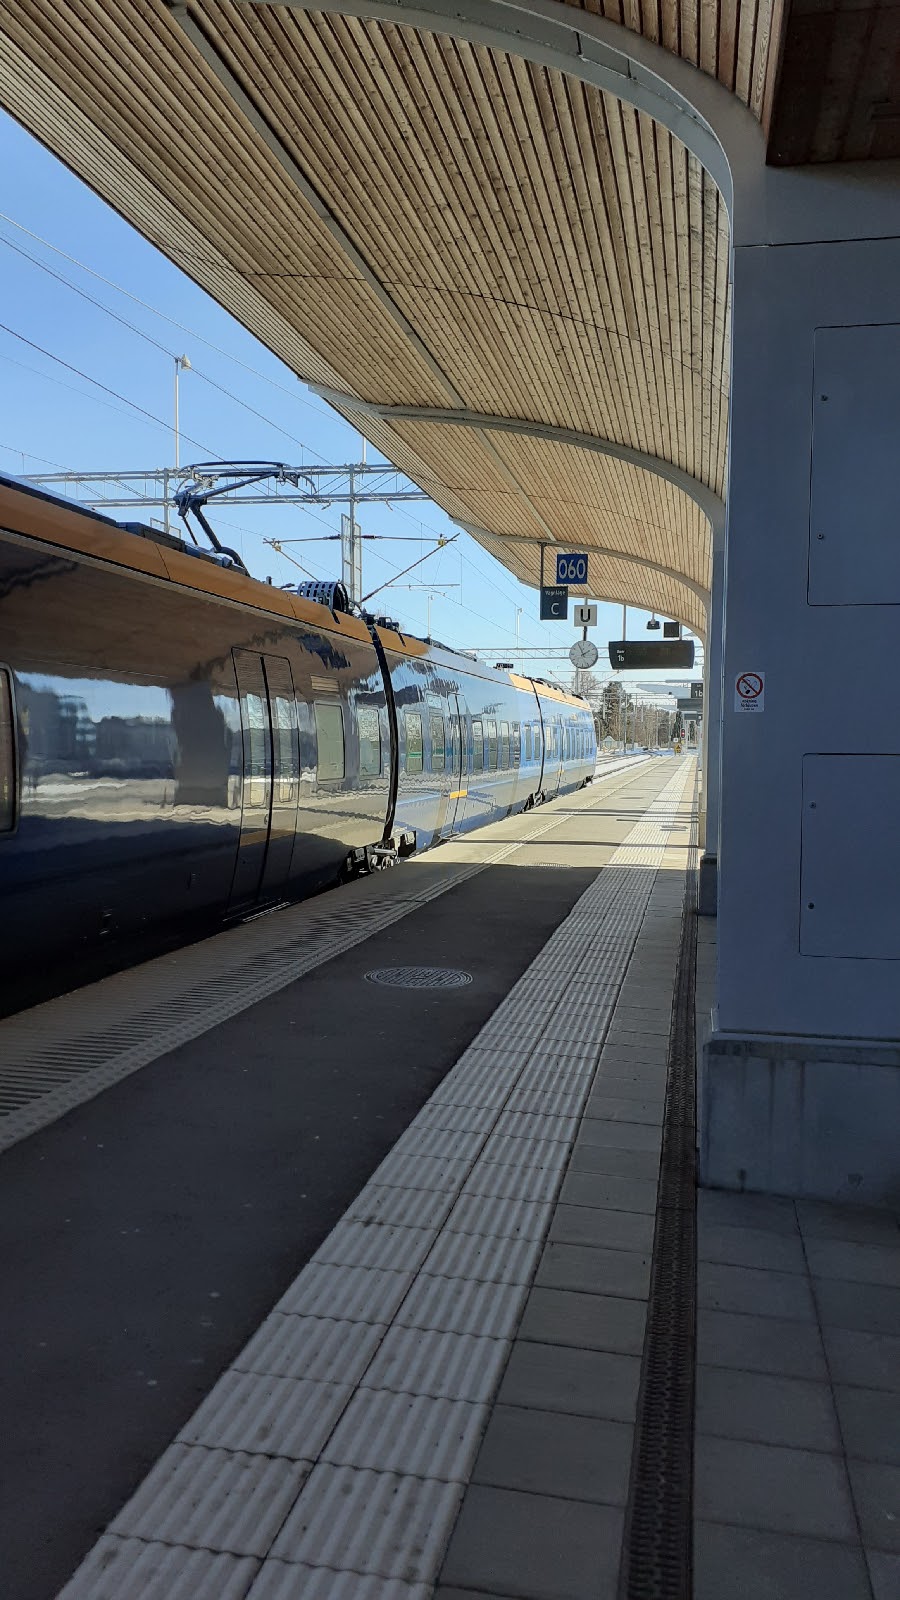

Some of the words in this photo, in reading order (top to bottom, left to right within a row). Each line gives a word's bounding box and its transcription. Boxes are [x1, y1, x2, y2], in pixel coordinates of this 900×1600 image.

[558, 559, 586, 579] 060
[550, 603, 560, 616] C
[580, 608, 591, 623] U
[617, 654, 625, 662] 1b
